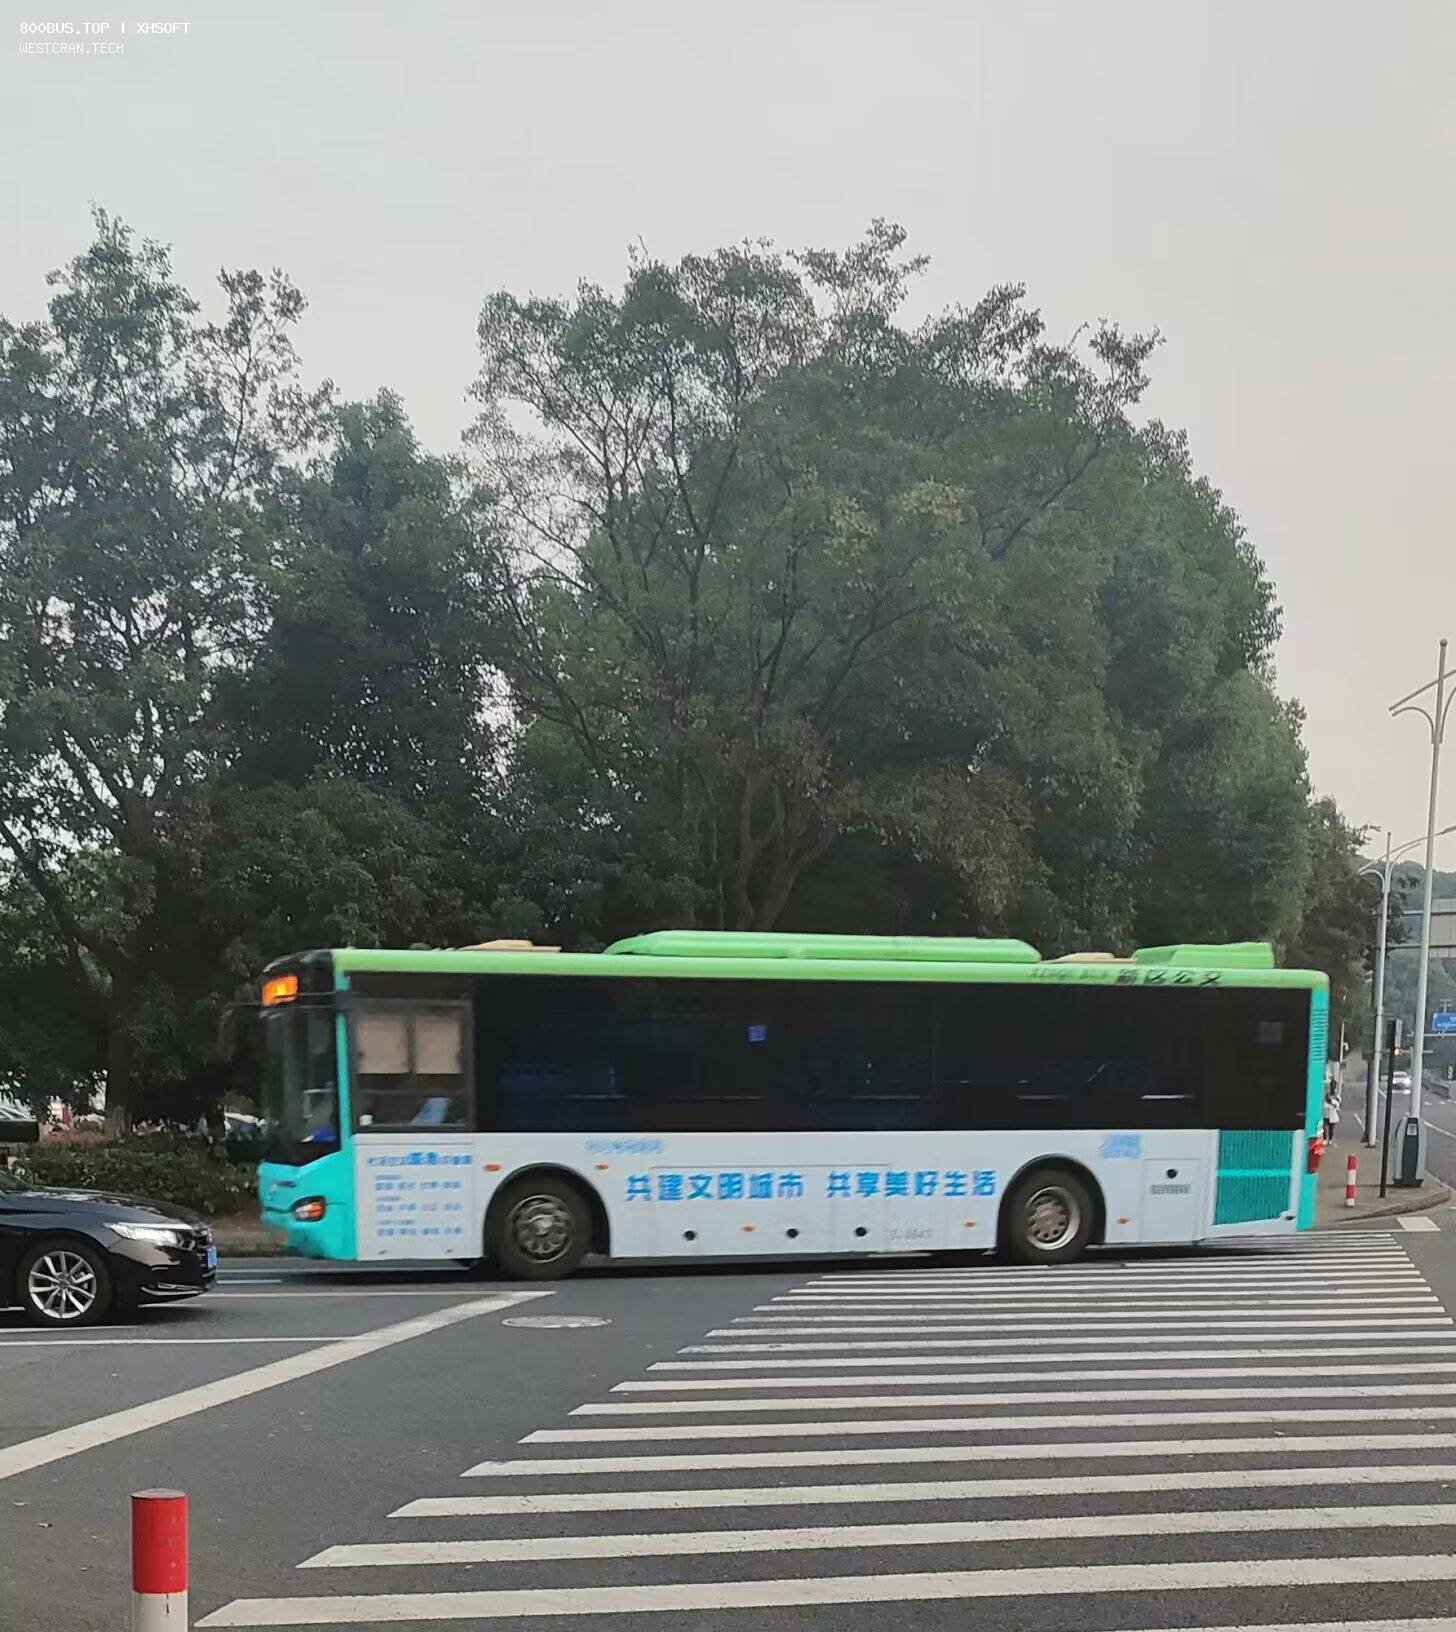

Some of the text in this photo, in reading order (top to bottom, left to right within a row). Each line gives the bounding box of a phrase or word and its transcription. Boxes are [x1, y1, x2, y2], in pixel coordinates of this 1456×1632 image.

[625, 1169, 997, 1201] 共建文明城市 共享美好生活
